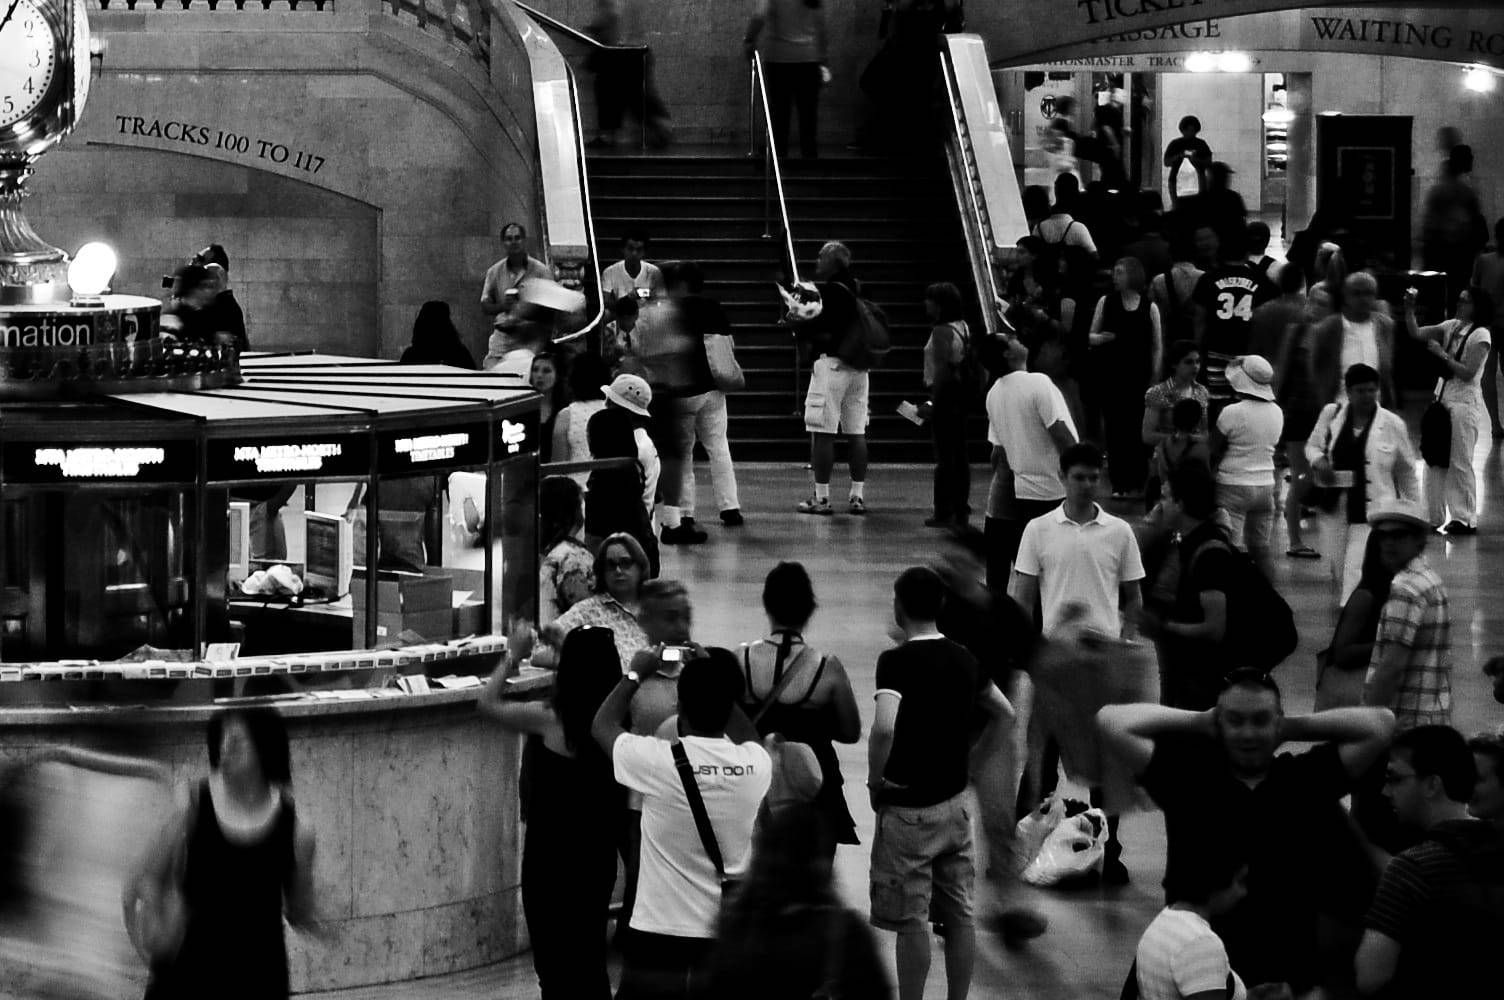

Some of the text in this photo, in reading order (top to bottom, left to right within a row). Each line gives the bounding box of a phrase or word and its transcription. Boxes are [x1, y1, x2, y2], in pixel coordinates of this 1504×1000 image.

[1311, 17, 1453, 49] WAITING
[116, 115, 326, 174] TRACKS 100 TO 117
[1216, 292, 1254, 321] 34
[692, 764, 719, 776] UST
